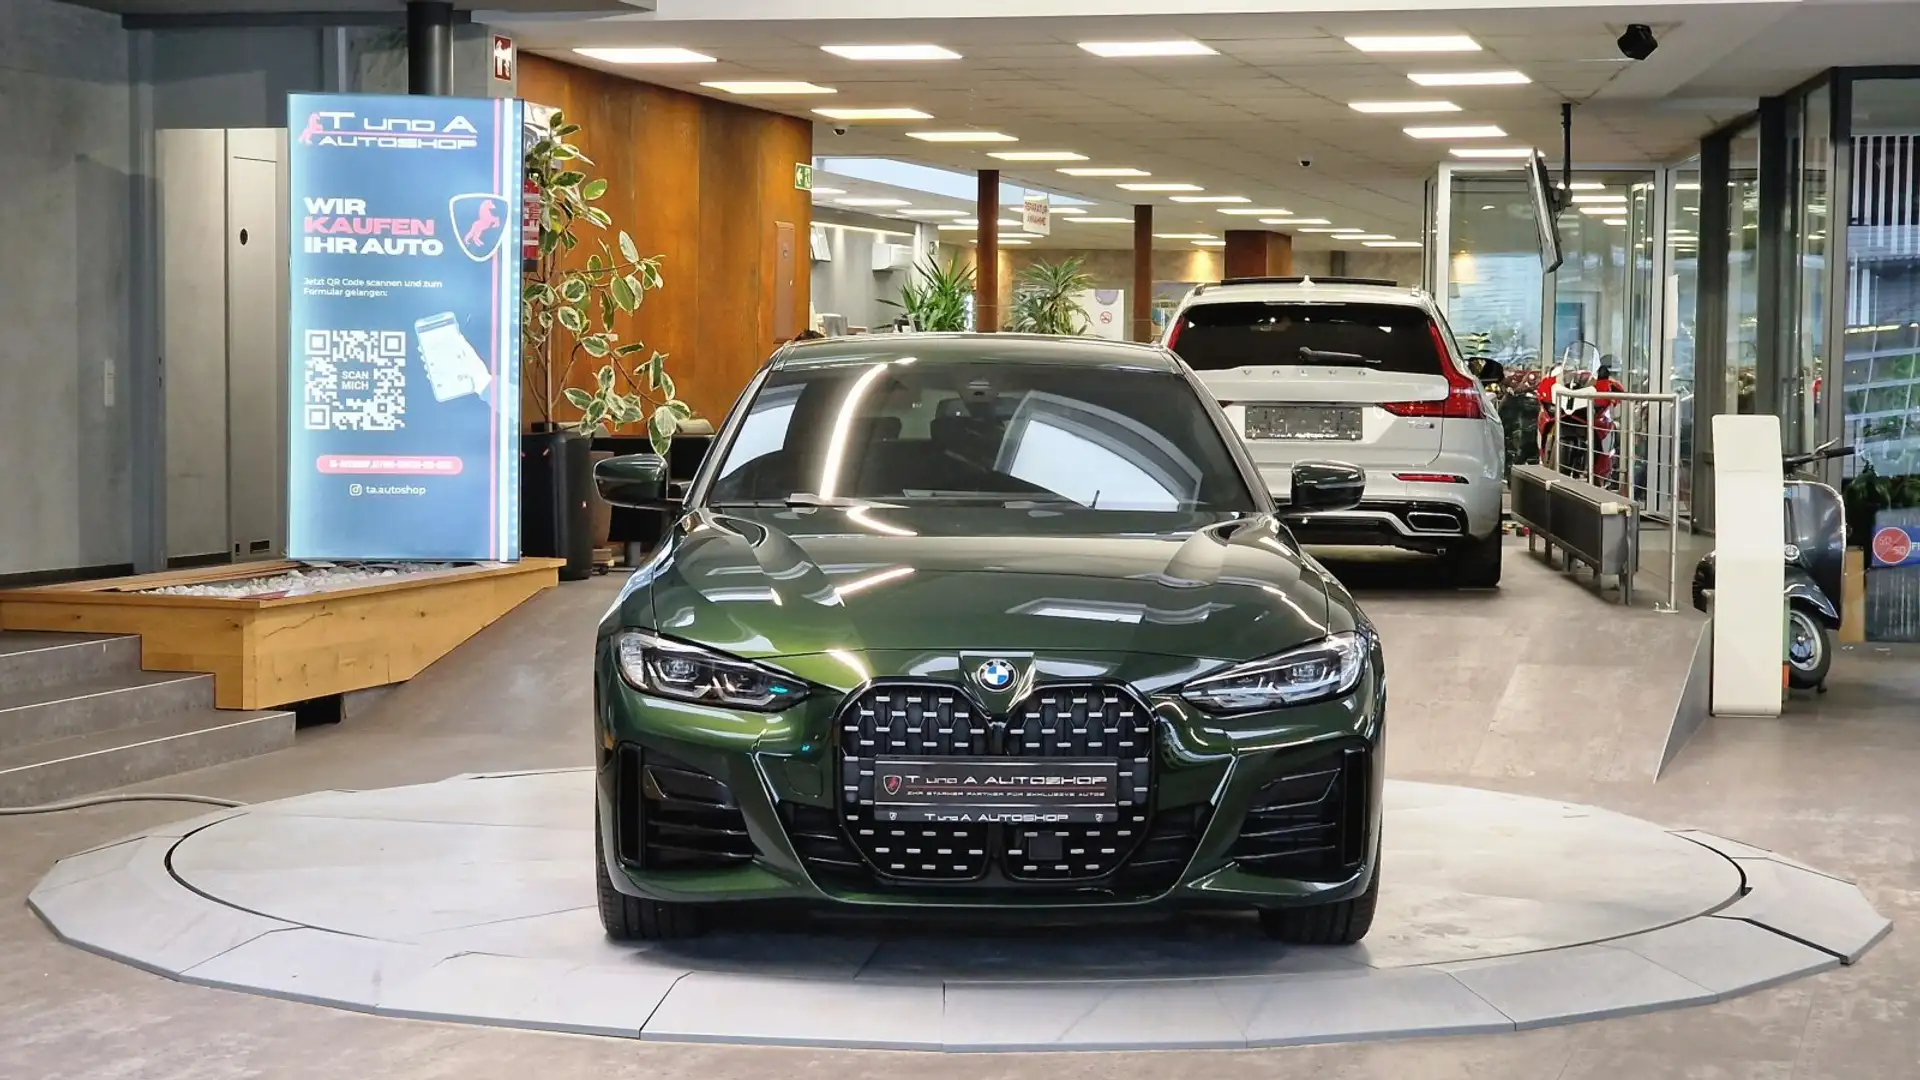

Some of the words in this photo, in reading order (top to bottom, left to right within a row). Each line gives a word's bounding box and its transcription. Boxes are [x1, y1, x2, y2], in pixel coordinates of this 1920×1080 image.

[319, 112, 355, 129] T
[442, 115, 477, 133] A
[319, 136, 477, 150] AUTOSHOP
[304, 197, 366, 215] WIR
[304, 216, 434, 235] KAUFEN
[304, 236, 358, 254] IHR
[361, 238, 444, 256] AUTO
[304, 278, 325, 286] Jetzt
[327, 278, 341, 287] QR
[342, 278, 364, 287] Code
[404, 279, 421, 287] und
[304, 287, 343, 296] Formular
[341, 370, 369, 380] SCAN
[341, 380, 369, 390] MICH
[366, 485, 426, 496] ta.autoshop
[904, 775, 920, 784] T
[963, 775, 978, 785] A
[984, 776, 1108, 785] AUTOSHOP
[978, 813, 1069, 822] AUTOSHOP
